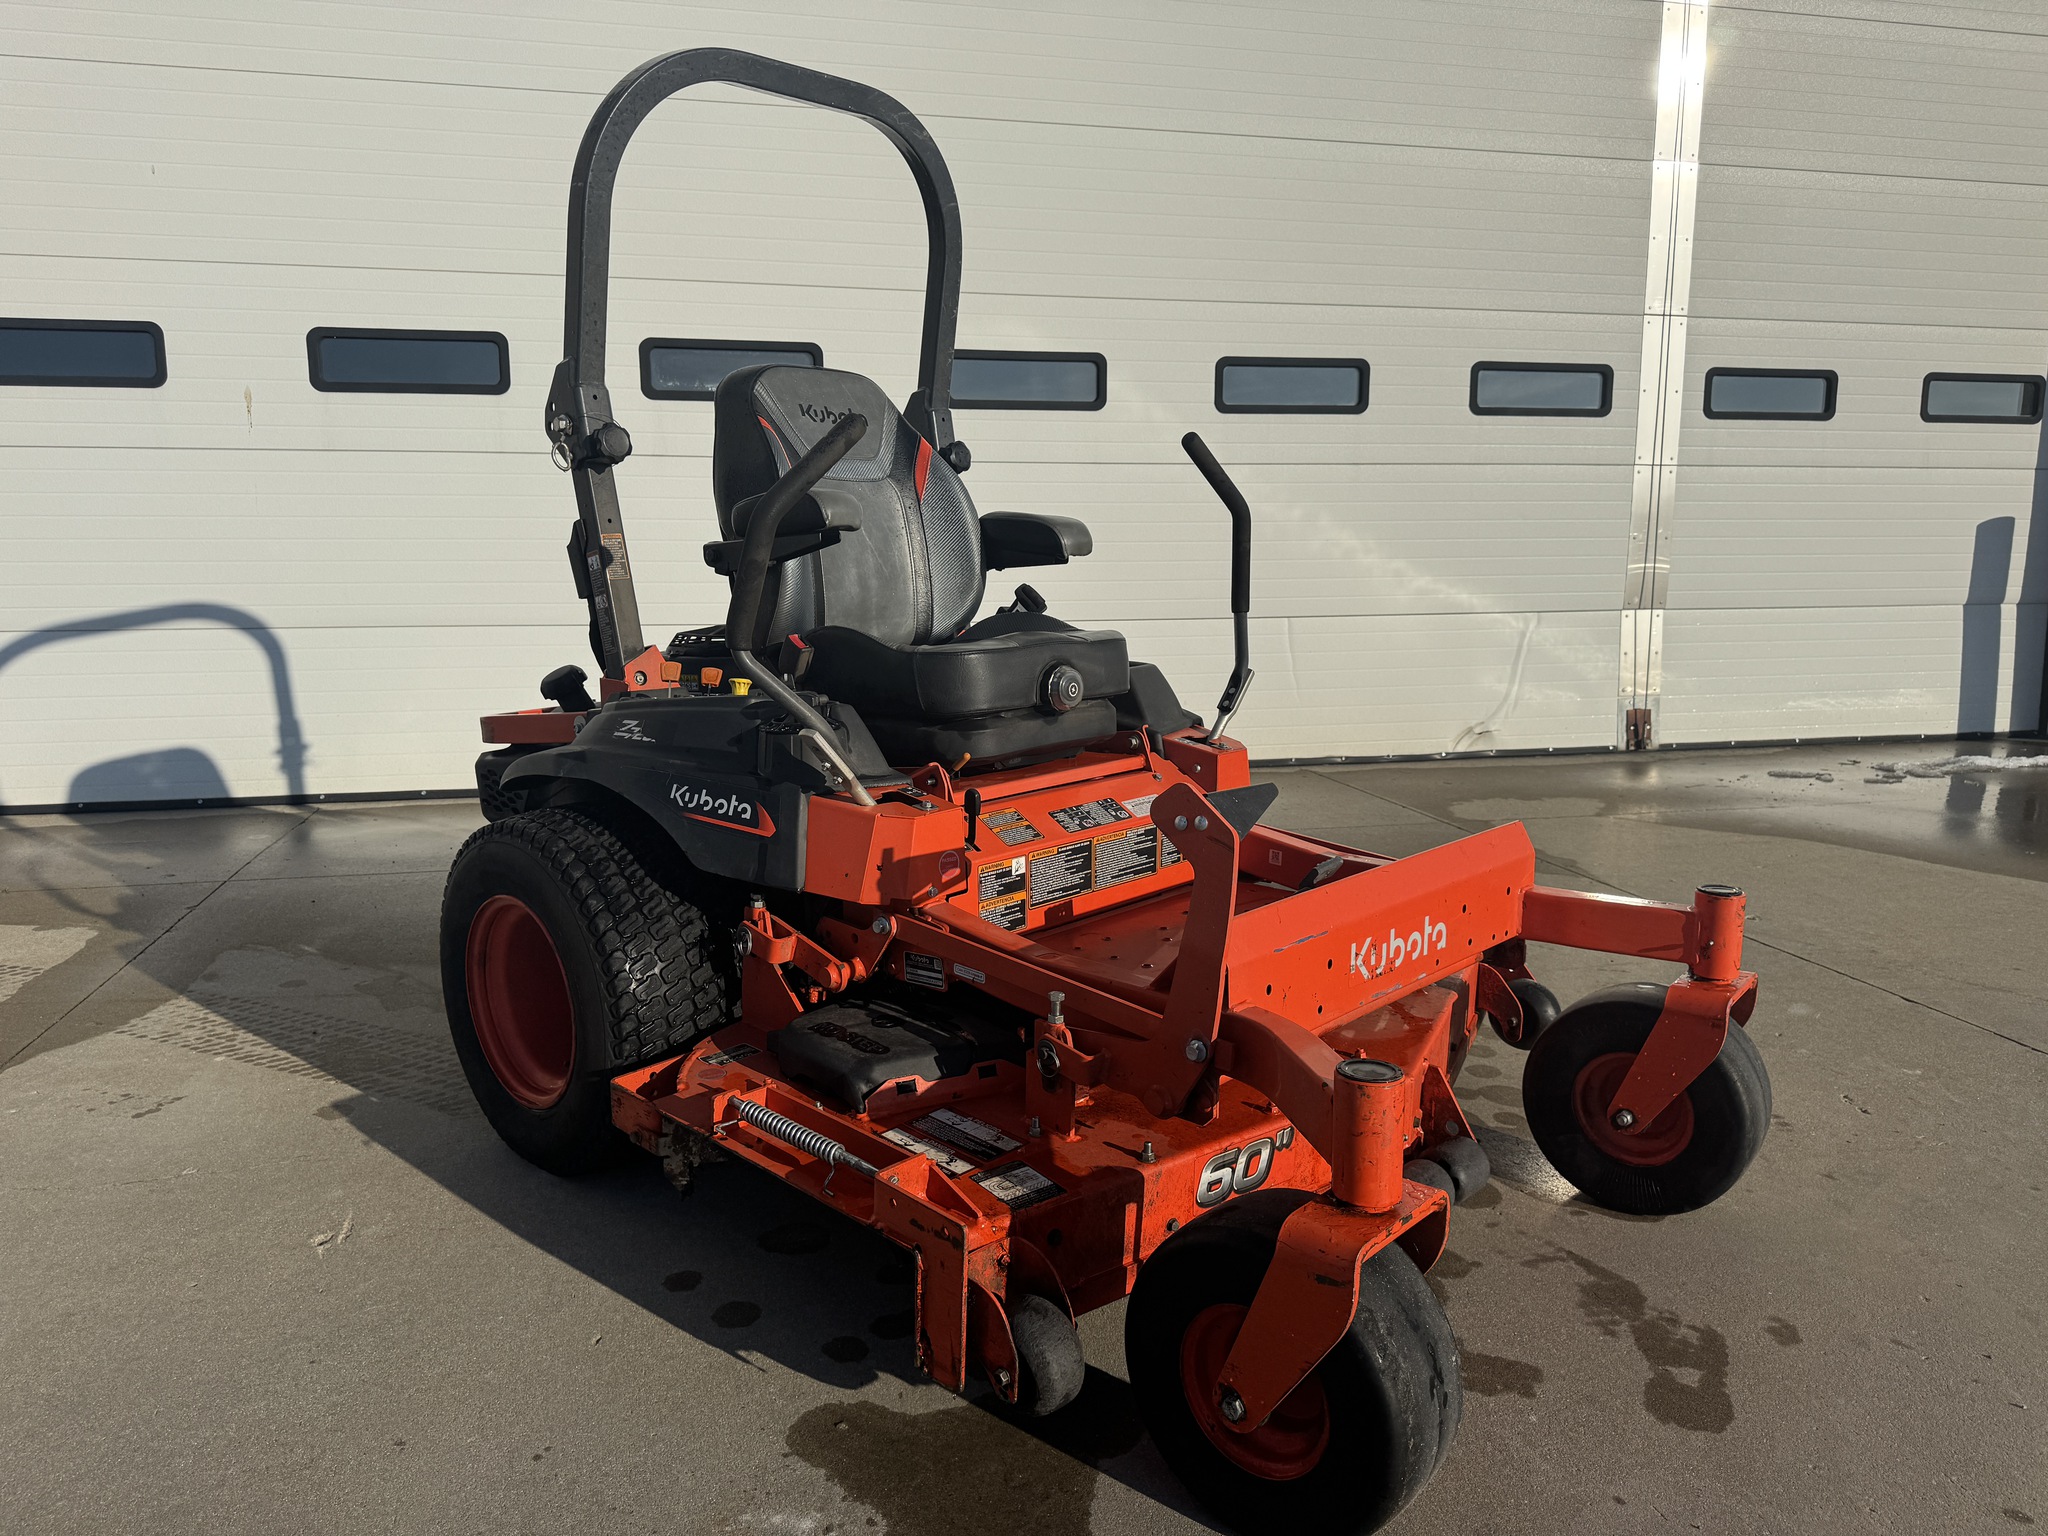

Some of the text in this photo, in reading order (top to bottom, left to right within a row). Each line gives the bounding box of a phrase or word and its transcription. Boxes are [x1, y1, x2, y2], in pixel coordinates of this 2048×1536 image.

[670, 783, 752, 820] Kubota
[984, 861, 1005, 871] WARNING
[985, 895, 1015, 907] ADVERTENCIA
[1350, 915, 1447, 981] Kubota
[927, 1138, 956, 1154] DANGER
[1195, 1126, 1295, 1208] 60"
